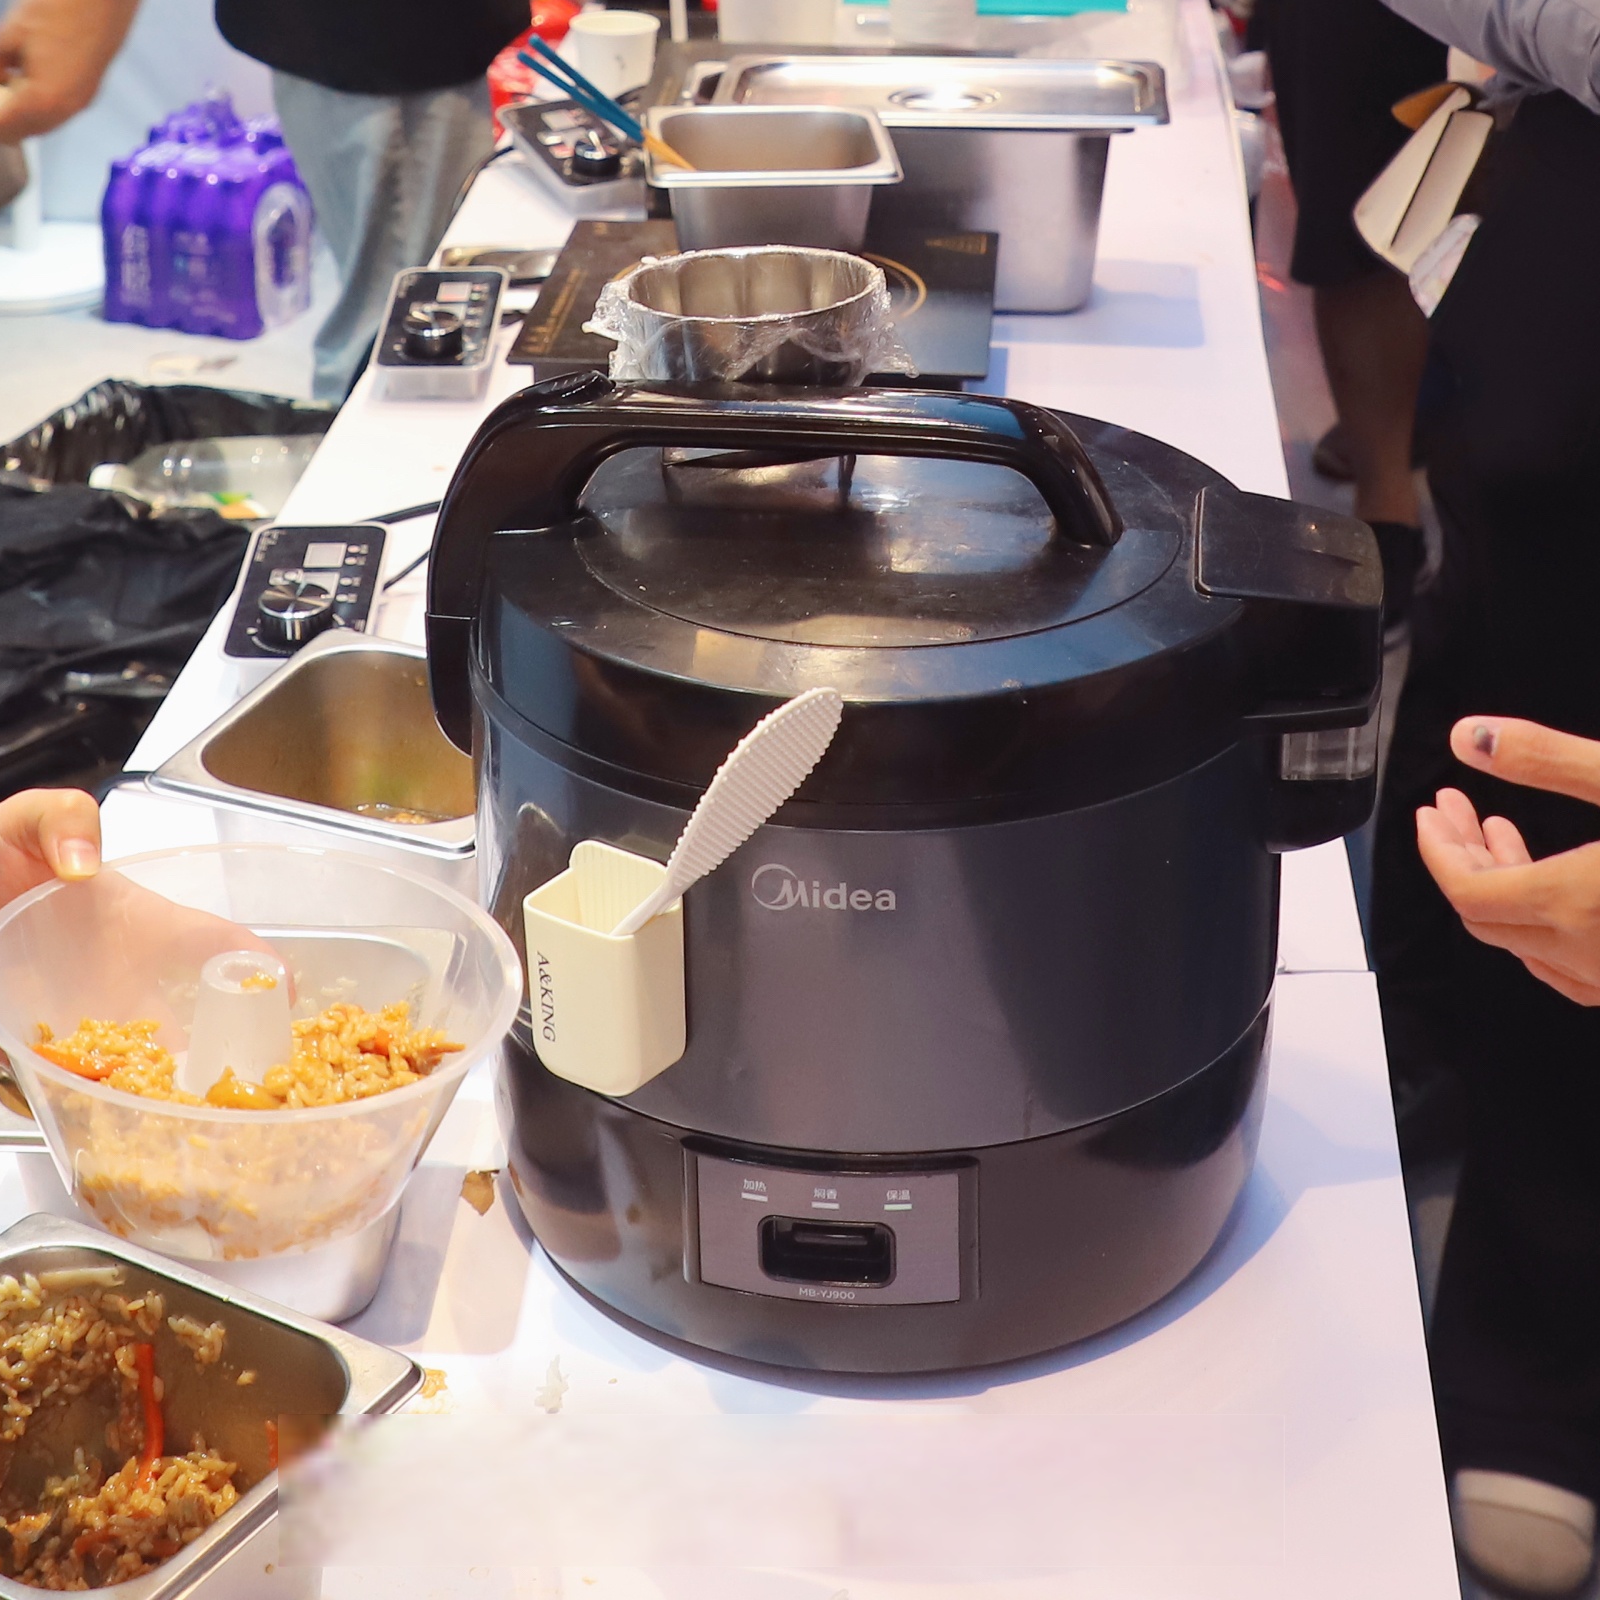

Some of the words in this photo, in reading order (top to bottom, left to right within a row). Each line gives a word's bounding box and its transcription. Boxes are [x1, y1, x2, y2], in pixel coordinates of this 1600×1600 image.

[751, 863, 897, 912] Midea
[536, 950, 557, 1043] A&KING
[743, 1178, 767, 1193] 加热
[886, 1189, 911, 1201] 保温
[799, 1287, 856, 1300] MB-YJ900
